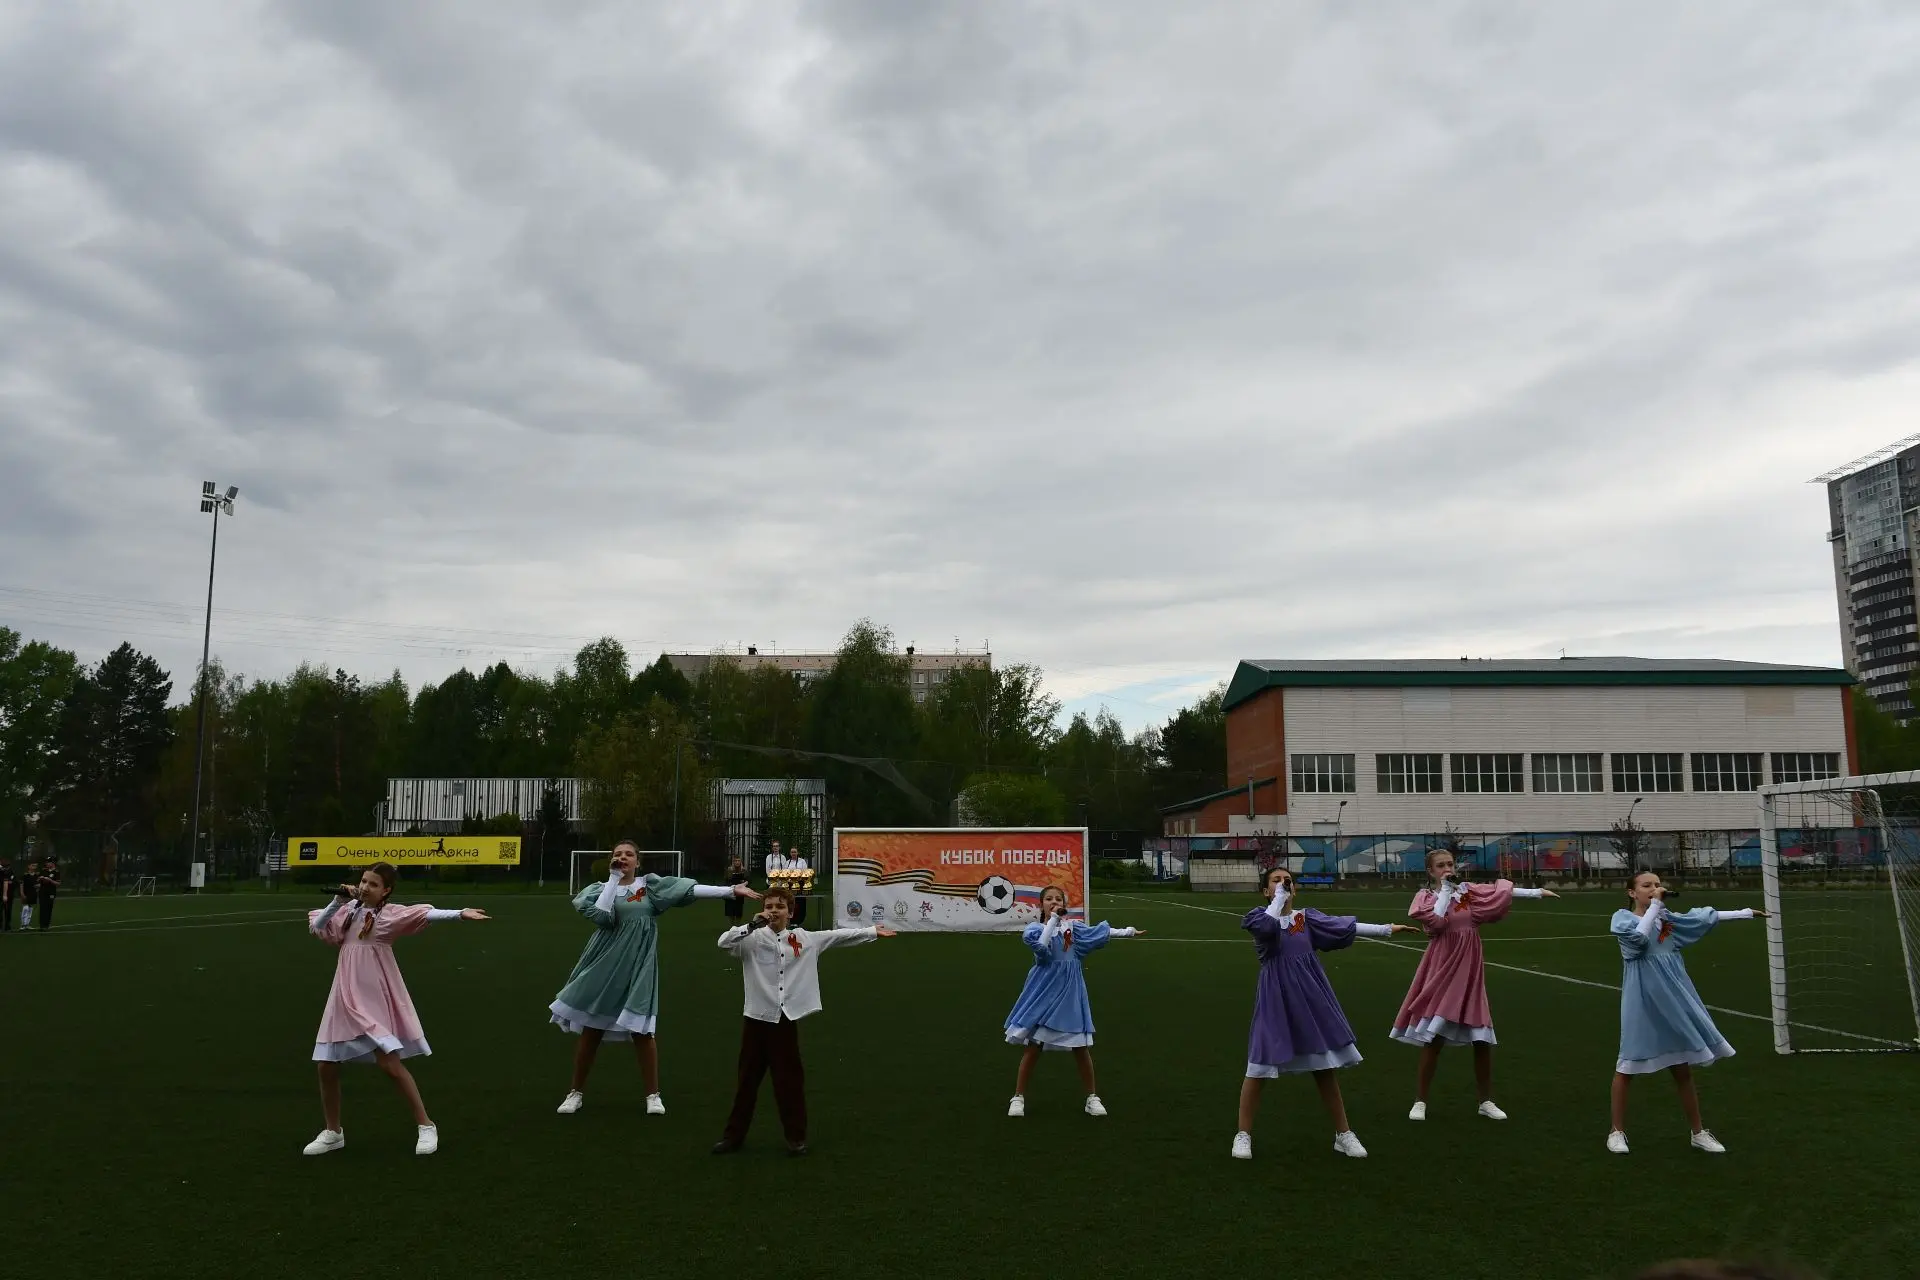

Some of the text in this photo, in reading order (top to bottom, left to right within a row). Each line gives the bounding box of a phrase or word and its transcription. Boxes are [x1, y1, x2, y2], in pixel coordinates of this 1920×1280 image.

[336, 846, 379, 858] Очень
[447, 848, 479, 857] окна
[940, 849, 1071, 866] КУБОК ПОБЕДЫ
